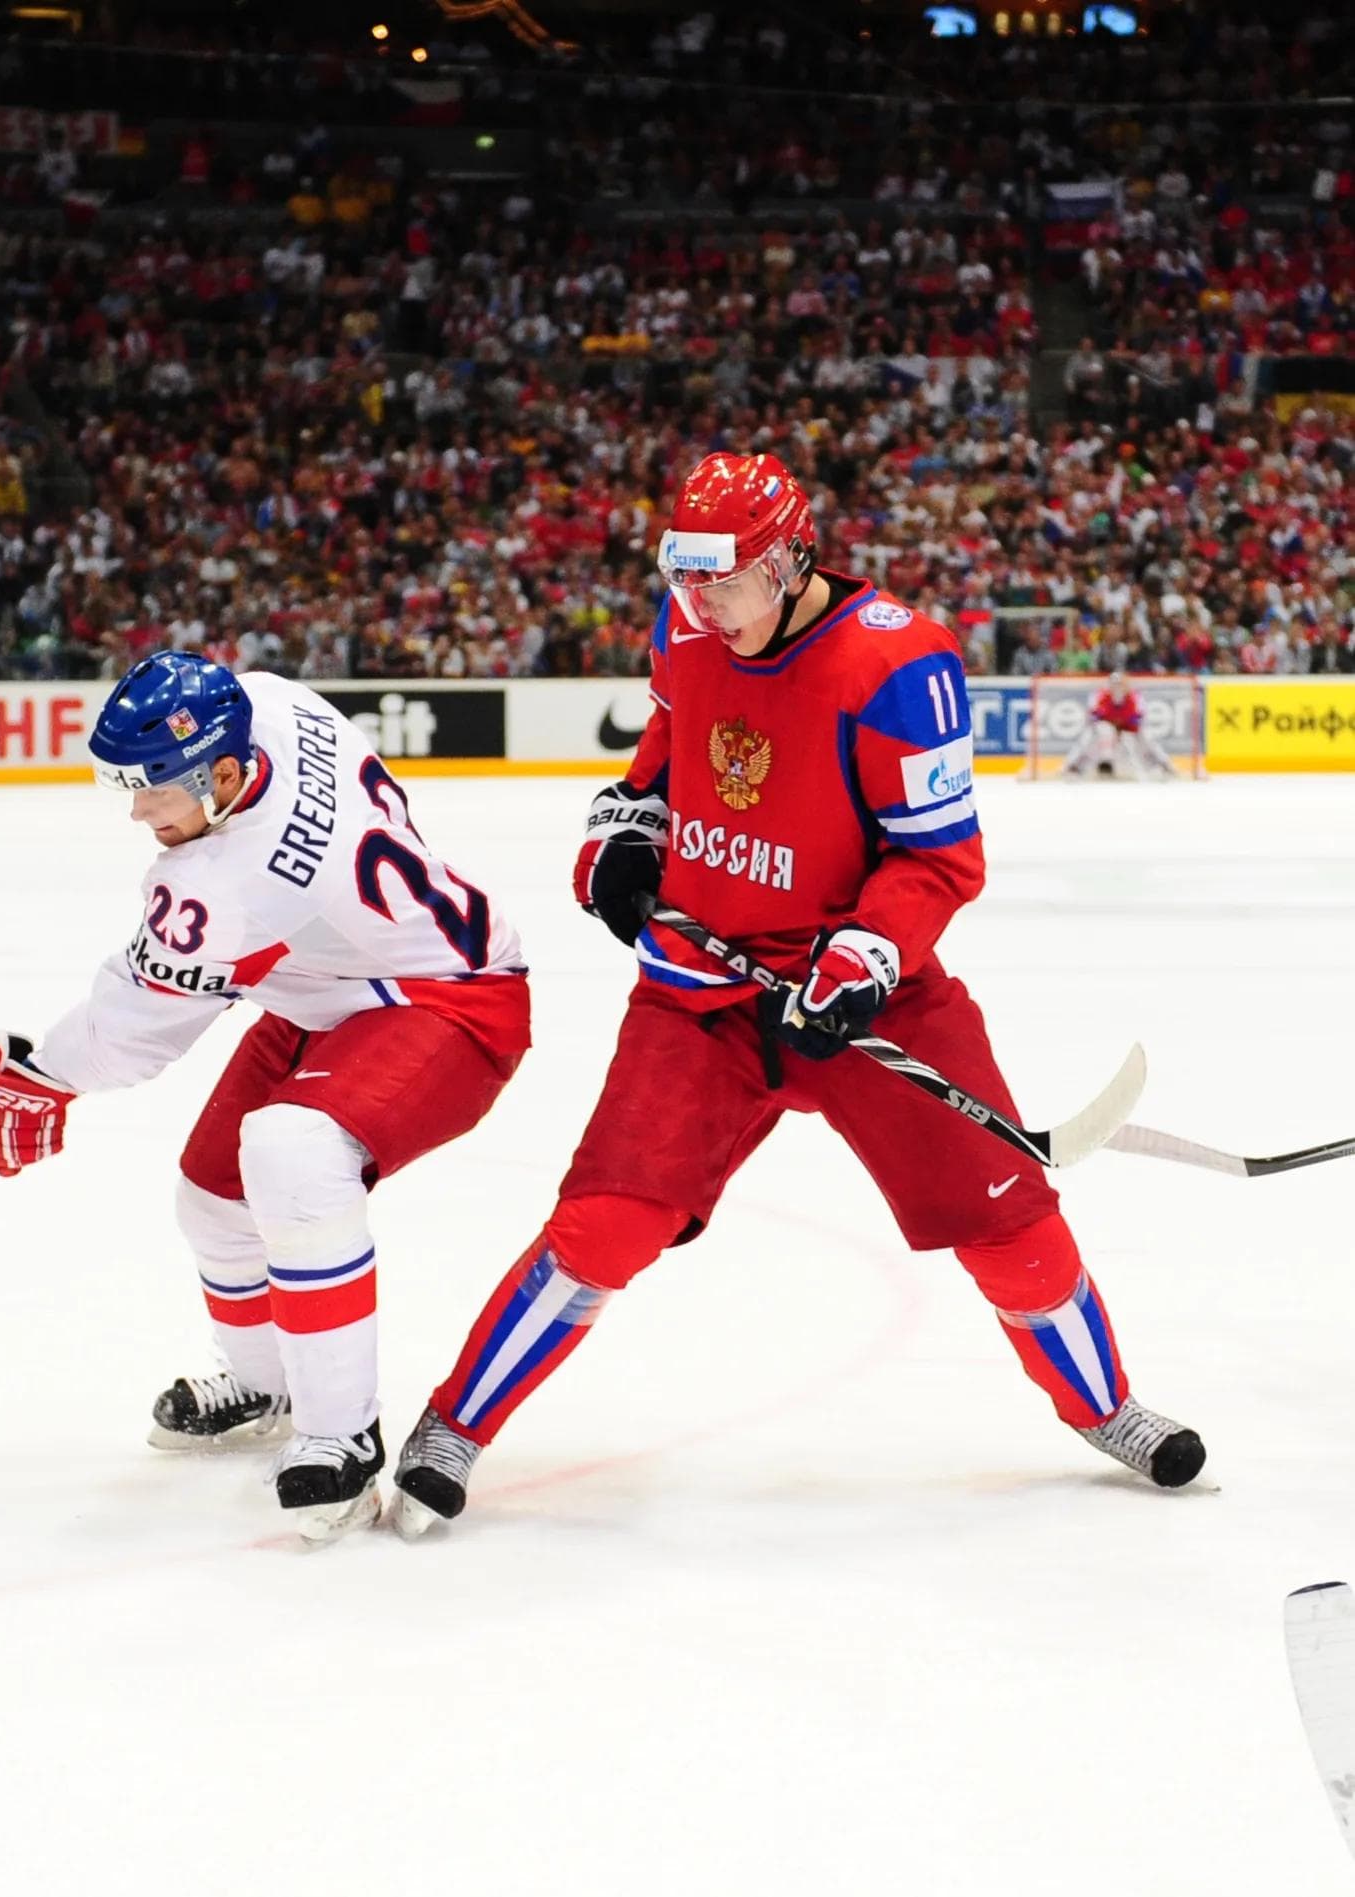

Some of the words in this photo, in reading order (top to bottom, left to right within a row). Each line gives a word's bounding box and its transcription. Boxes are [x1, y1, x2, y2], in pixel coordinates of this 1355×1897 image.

[928, 669, 958, 735] 11
[182, 725, 227, 760] Reebok
[267, 703, 337, 889] GREGOREK
[147, 884, 209, 955] 23
[704, 936, 782, 990] FAC
[944, 1088, 991, 1126] S19
